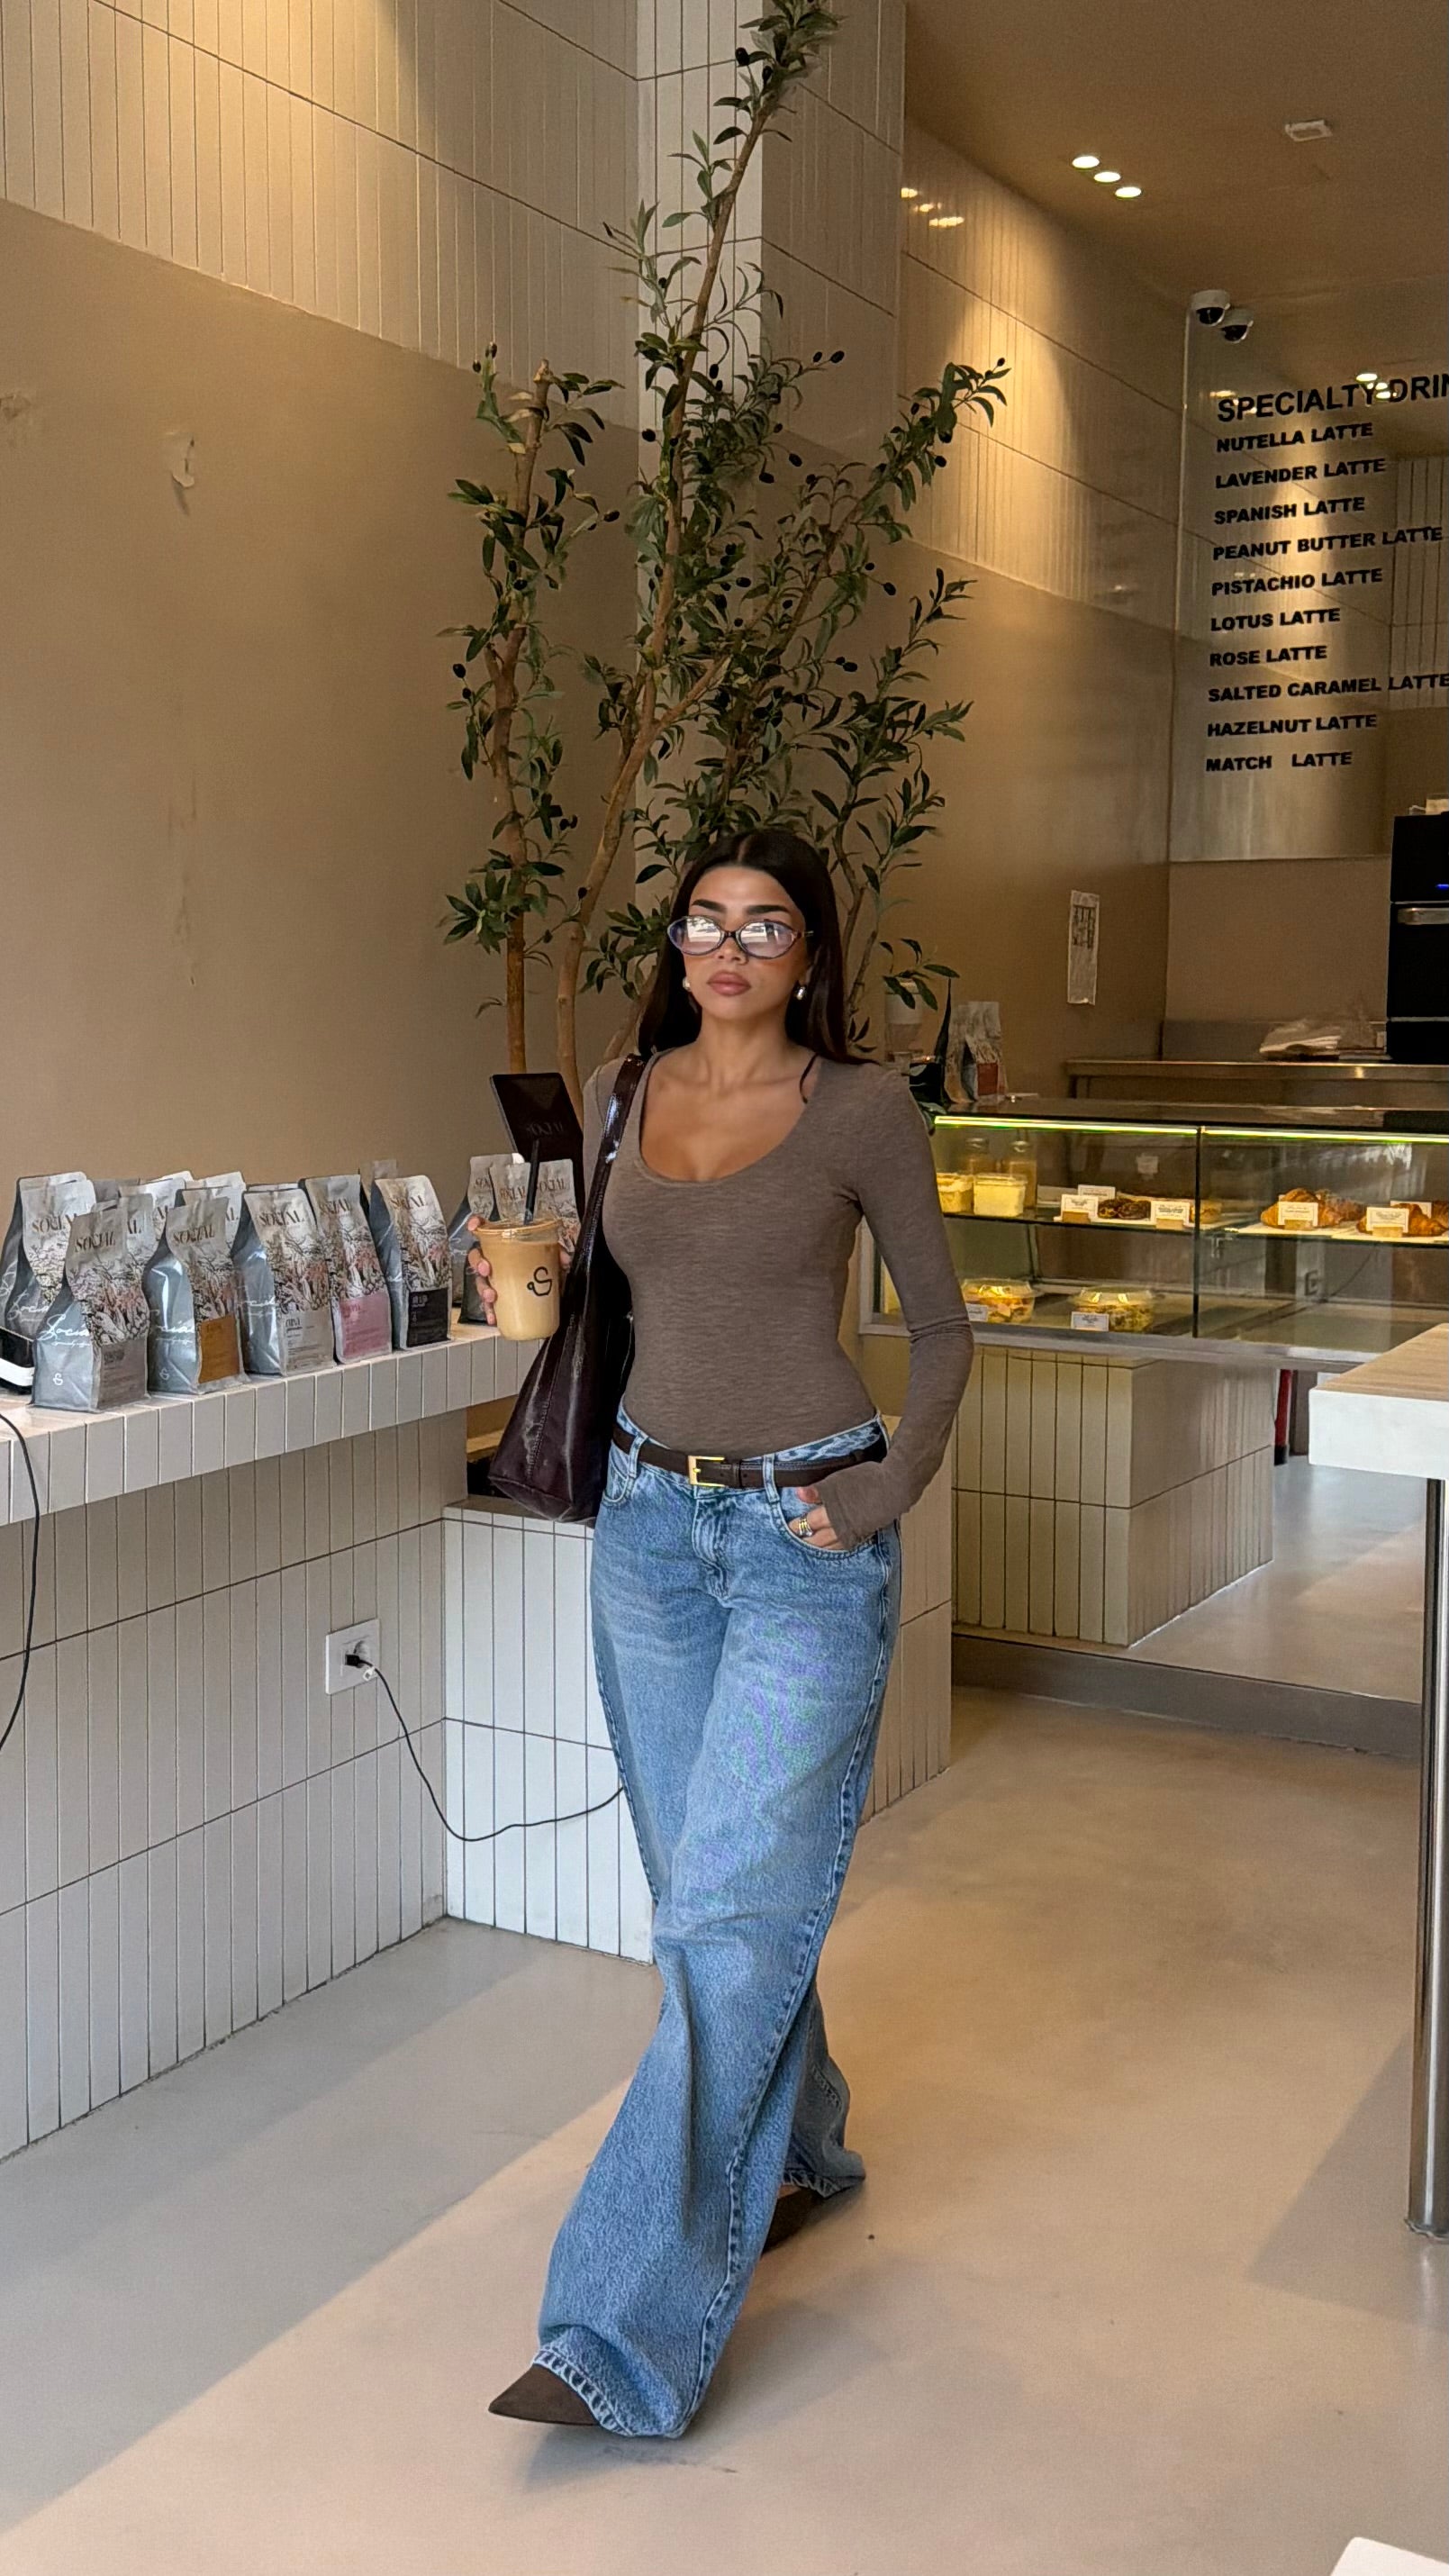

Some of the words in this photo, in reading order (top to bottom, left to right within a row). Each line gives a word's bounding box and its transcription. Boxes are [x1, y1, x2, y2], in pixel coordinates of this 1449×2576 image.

[1218, 383, 1375, 422] SPECIALTY
[1217, 431, 1304, 452] NUTELLA
[1311, 422, 1372, 442] LATTE
[1216, 465, 1318, 488] LAVENDER
[1324, 458, 1386, 477] LATTE
[1214, 503, 1297, 524] SPANISH
[1304, 497, 1364, 515] LATTE
[1213, 540, 1291, 559] PEANUT
[1298, 532, 1375, 552] BUTTER
[1382, 526, 1443, 545] LATTE
[1212, 575, 1315, 595] PISTACHIO
[1321, 568, 1382, 586] LATTE
[1211, 613, 1273, 631] LOTUS
[1280, 608, 1341, 626] LATTE
[1209, 650, 1260, 667] ROSE
[1266, 646, 1327, 662] LATTE
[1209, 685, 1281, 702] SALTED
[1288, 677, 1381, 695] CARAMEL
[1388, 673, 1449, 691] LATTE
[1208, 719, 1311, 737] HAZELNUT
[1316, 714, 1377, 730] LATTE
[1206, 756, 1272, 771] MATCH
[1291, 751, 1353, 767] LATTE
[537, 1178, 566, 1192] OCIAL
